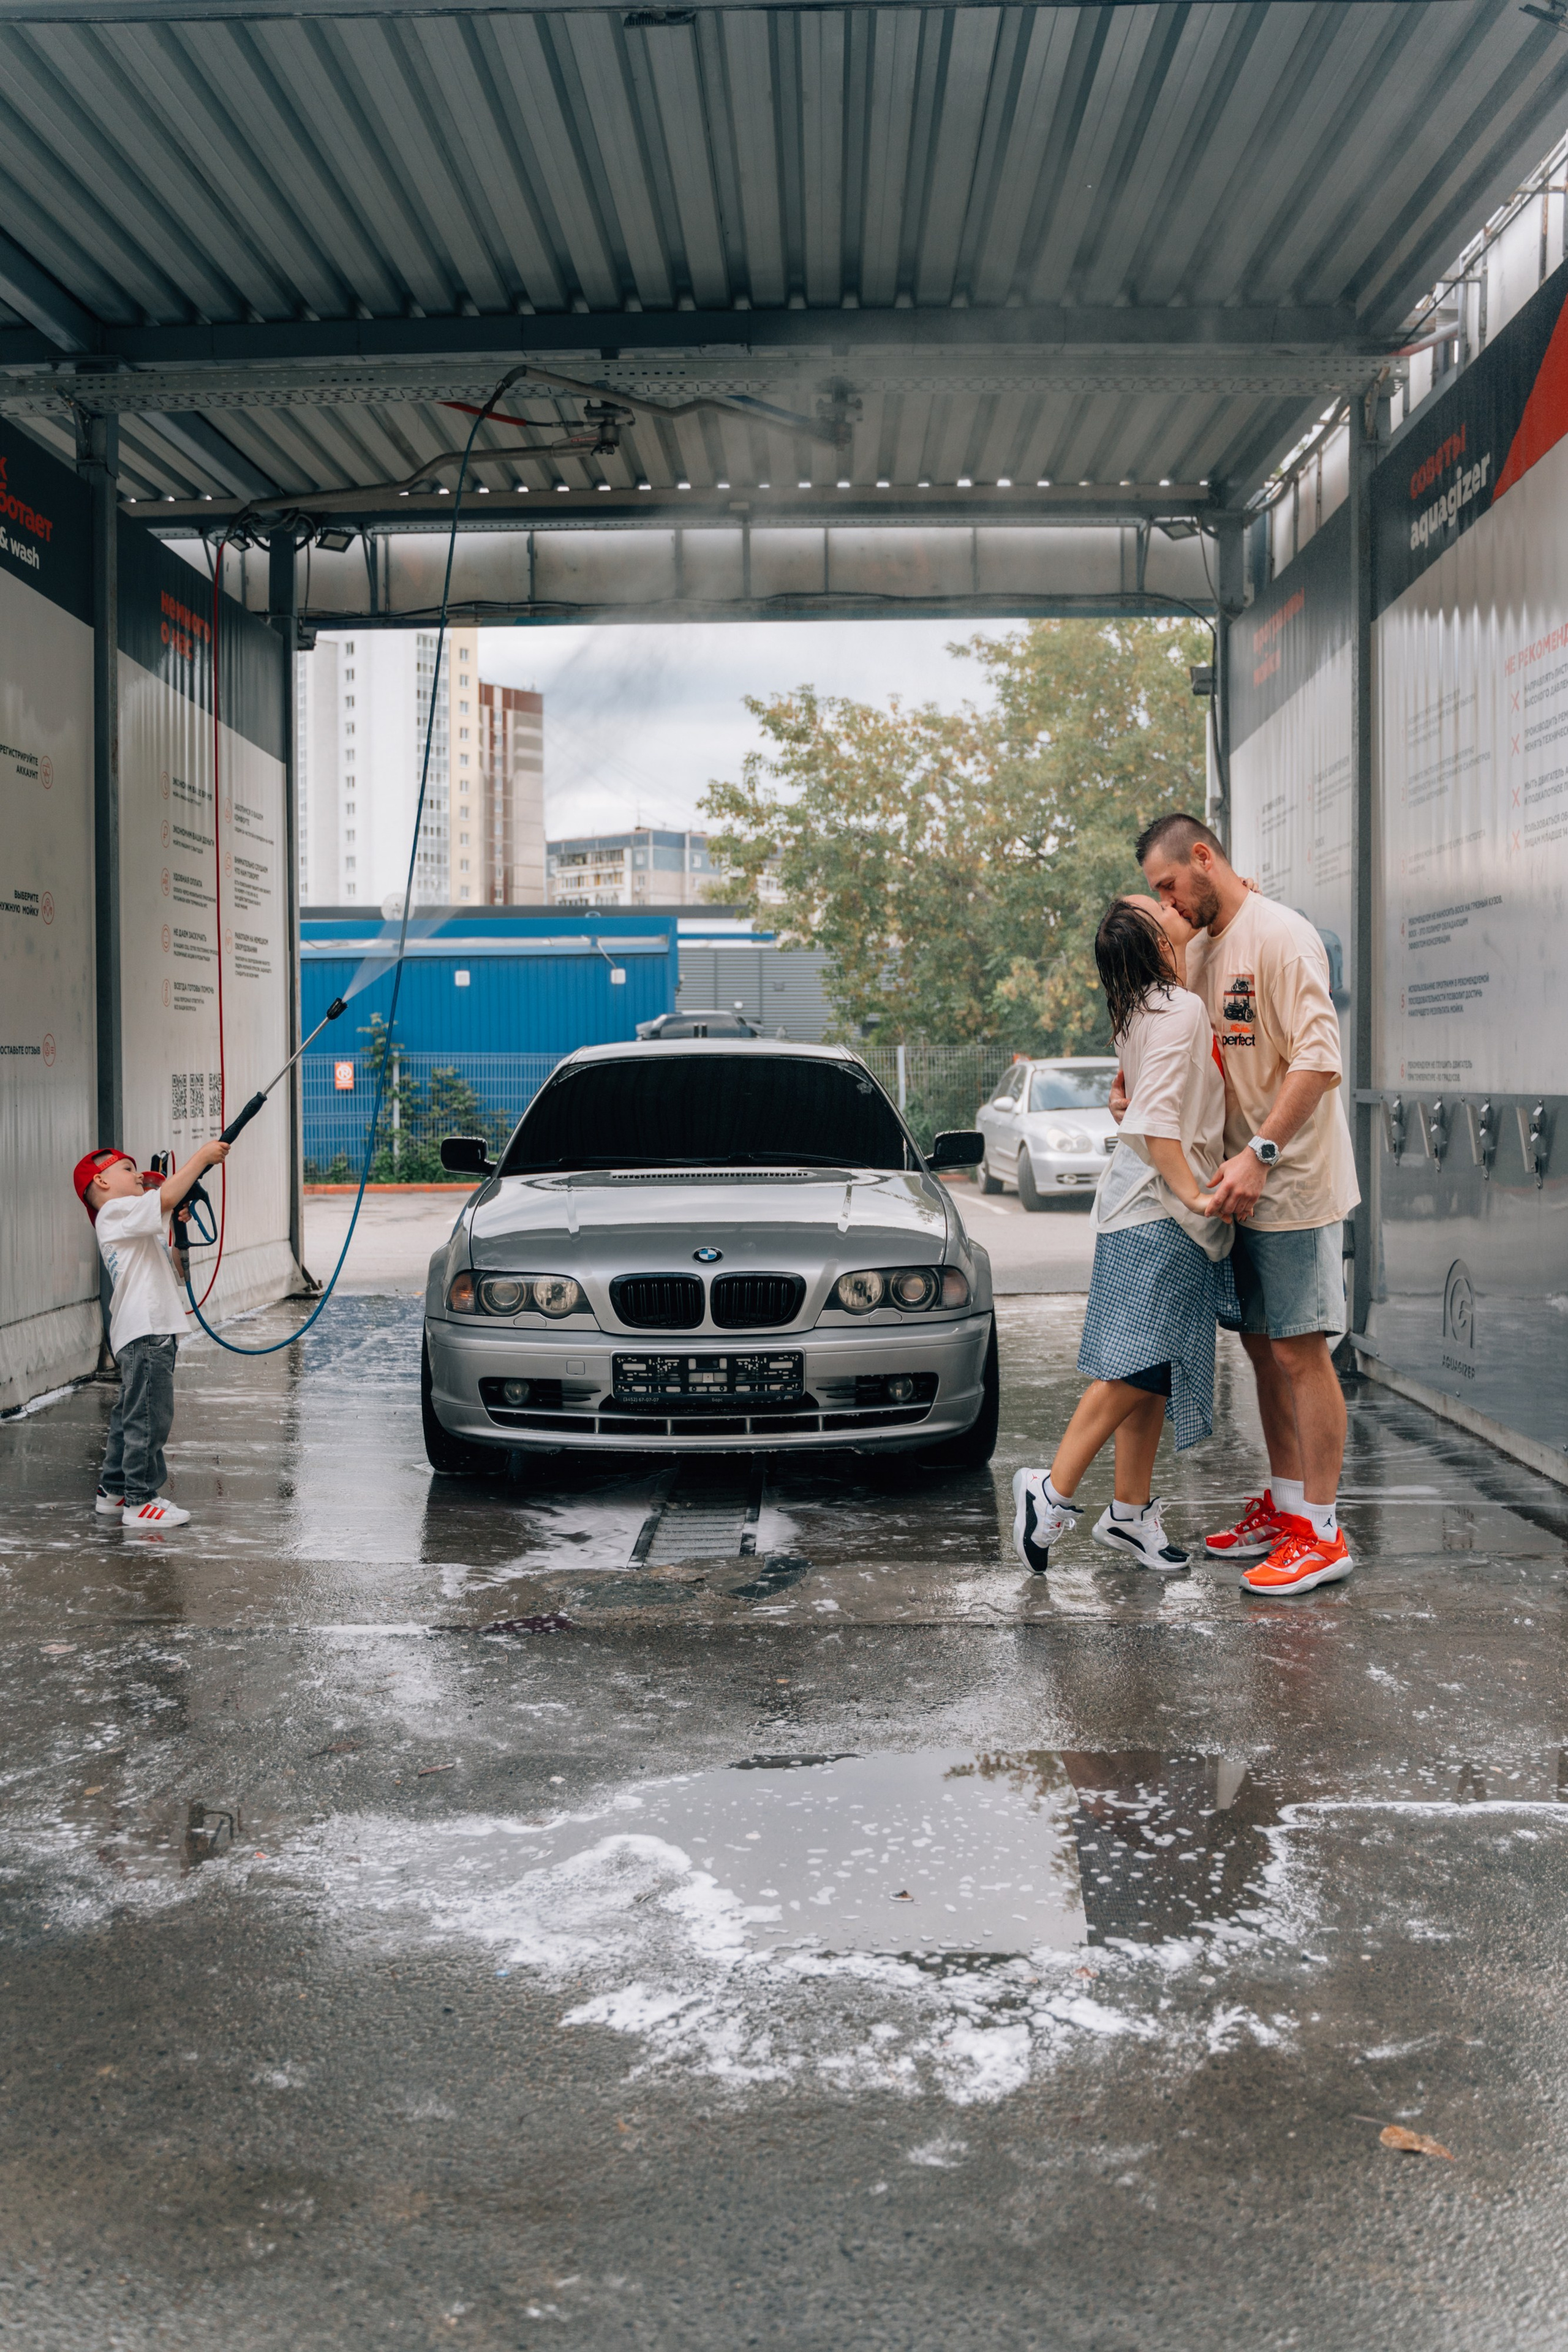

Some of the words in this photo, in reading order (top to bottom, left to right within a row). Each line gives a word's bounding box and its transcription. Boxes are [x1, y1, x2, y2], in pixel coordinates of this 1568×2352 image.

[1411, 423, 1466, 499] советы
[1411, 452, 1490, 550] aquagizer
[10, 537, 39, 570] wash
[1504, 654, 1515, 678] НЕ
[1525, 688, 1550, 709] ВЫСОКОГО
[1525, 716, 1558, 738] ПРОИЗВОДИТЬ
[16, 764, 39, 780] АККАУНТ
[1538, 768, 1564, 786] ДВИГАТЕЛЬ
[1528, 786, 1562, 804] ПОДКАПОТНОЕ
[1525, 813, 1560, 834] ПОЛЬЗОВАТЬСЯ
[1525, 836, 1540, 849] ЛИЦАМ
[14, 889, 39, 903] ВЫБЕРИТЕ
[22, 905, 39, 917] МОЙКУ
[1222, 1033, 1256, 1047] perfect
[0, 1045, 24, 1055] ОСТАВЬТЕ
[24, 1046, 40, 1055] ОТЗЫВ
